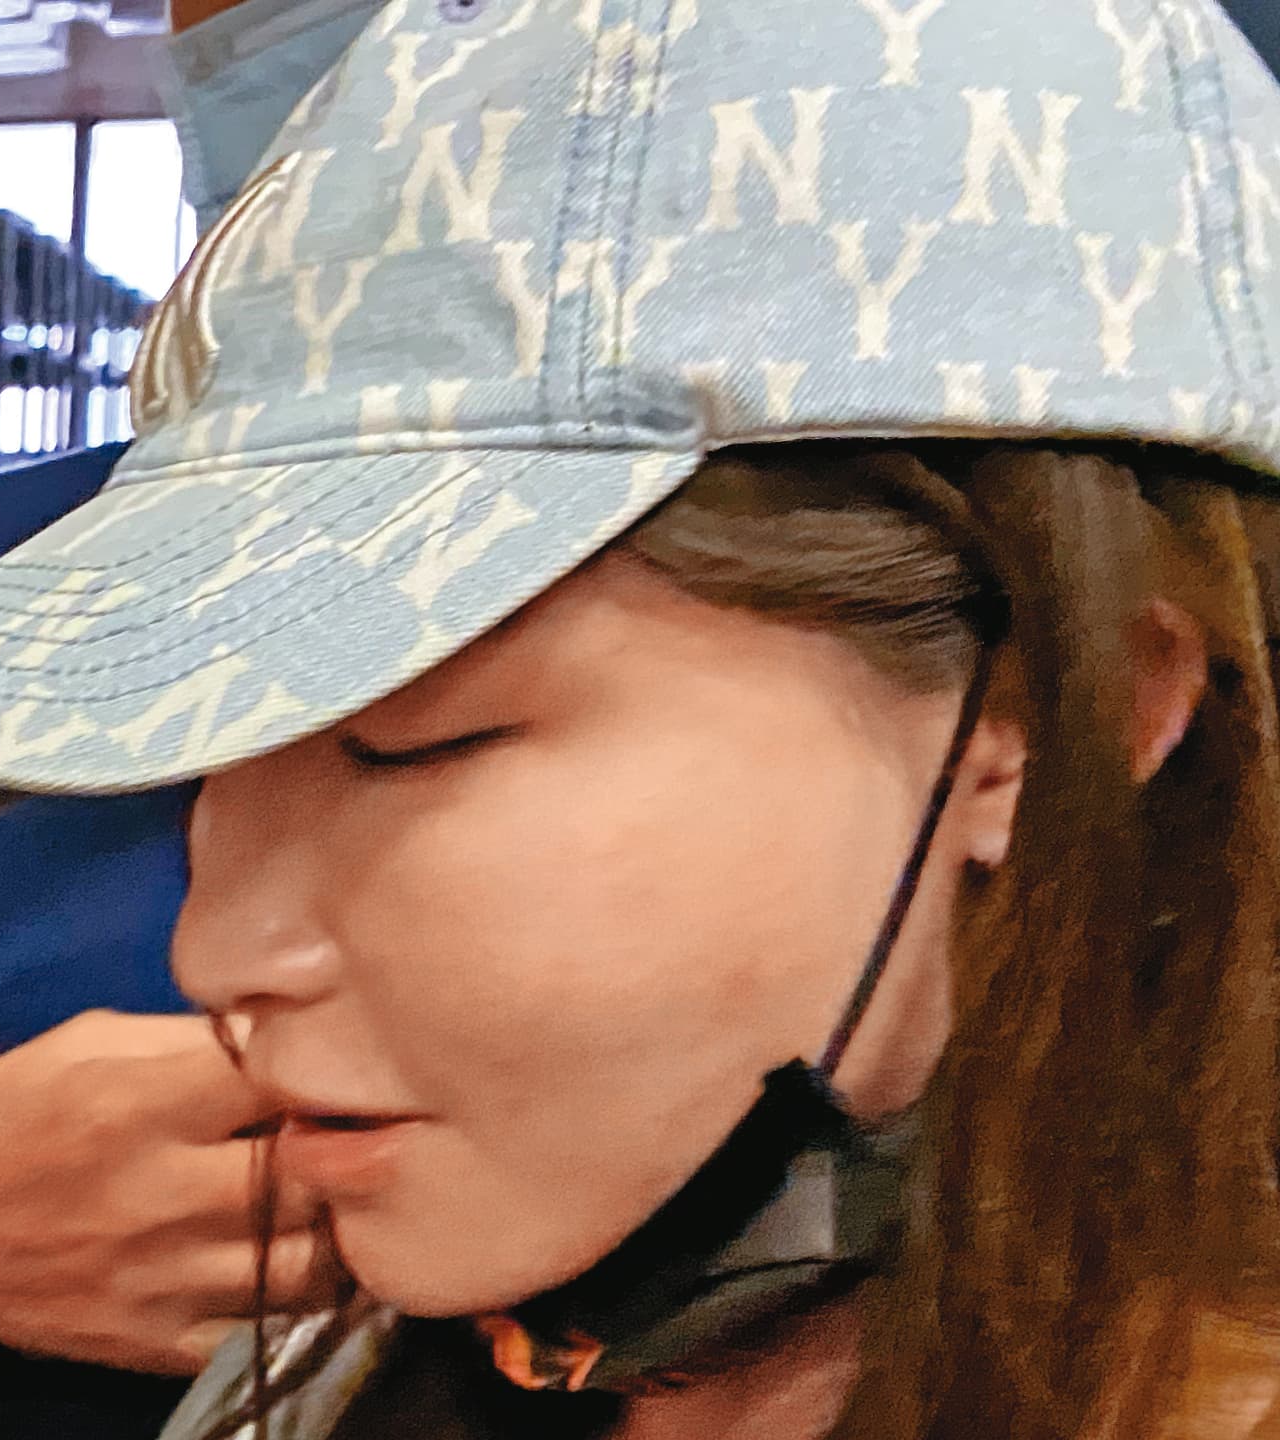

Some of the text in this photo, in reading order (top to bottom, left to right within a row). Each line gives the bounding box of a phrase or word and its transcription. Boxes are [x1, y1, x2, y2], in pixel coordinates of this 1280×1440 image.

[381, 107, 529, 257] N
[696, 85, 836, 232] N
[948, 87, 1082, 227] N
[293, 258, 378, 399] Y
[828, 219, 942, 362] Y
[1073, 231, 1168, 379] Y
